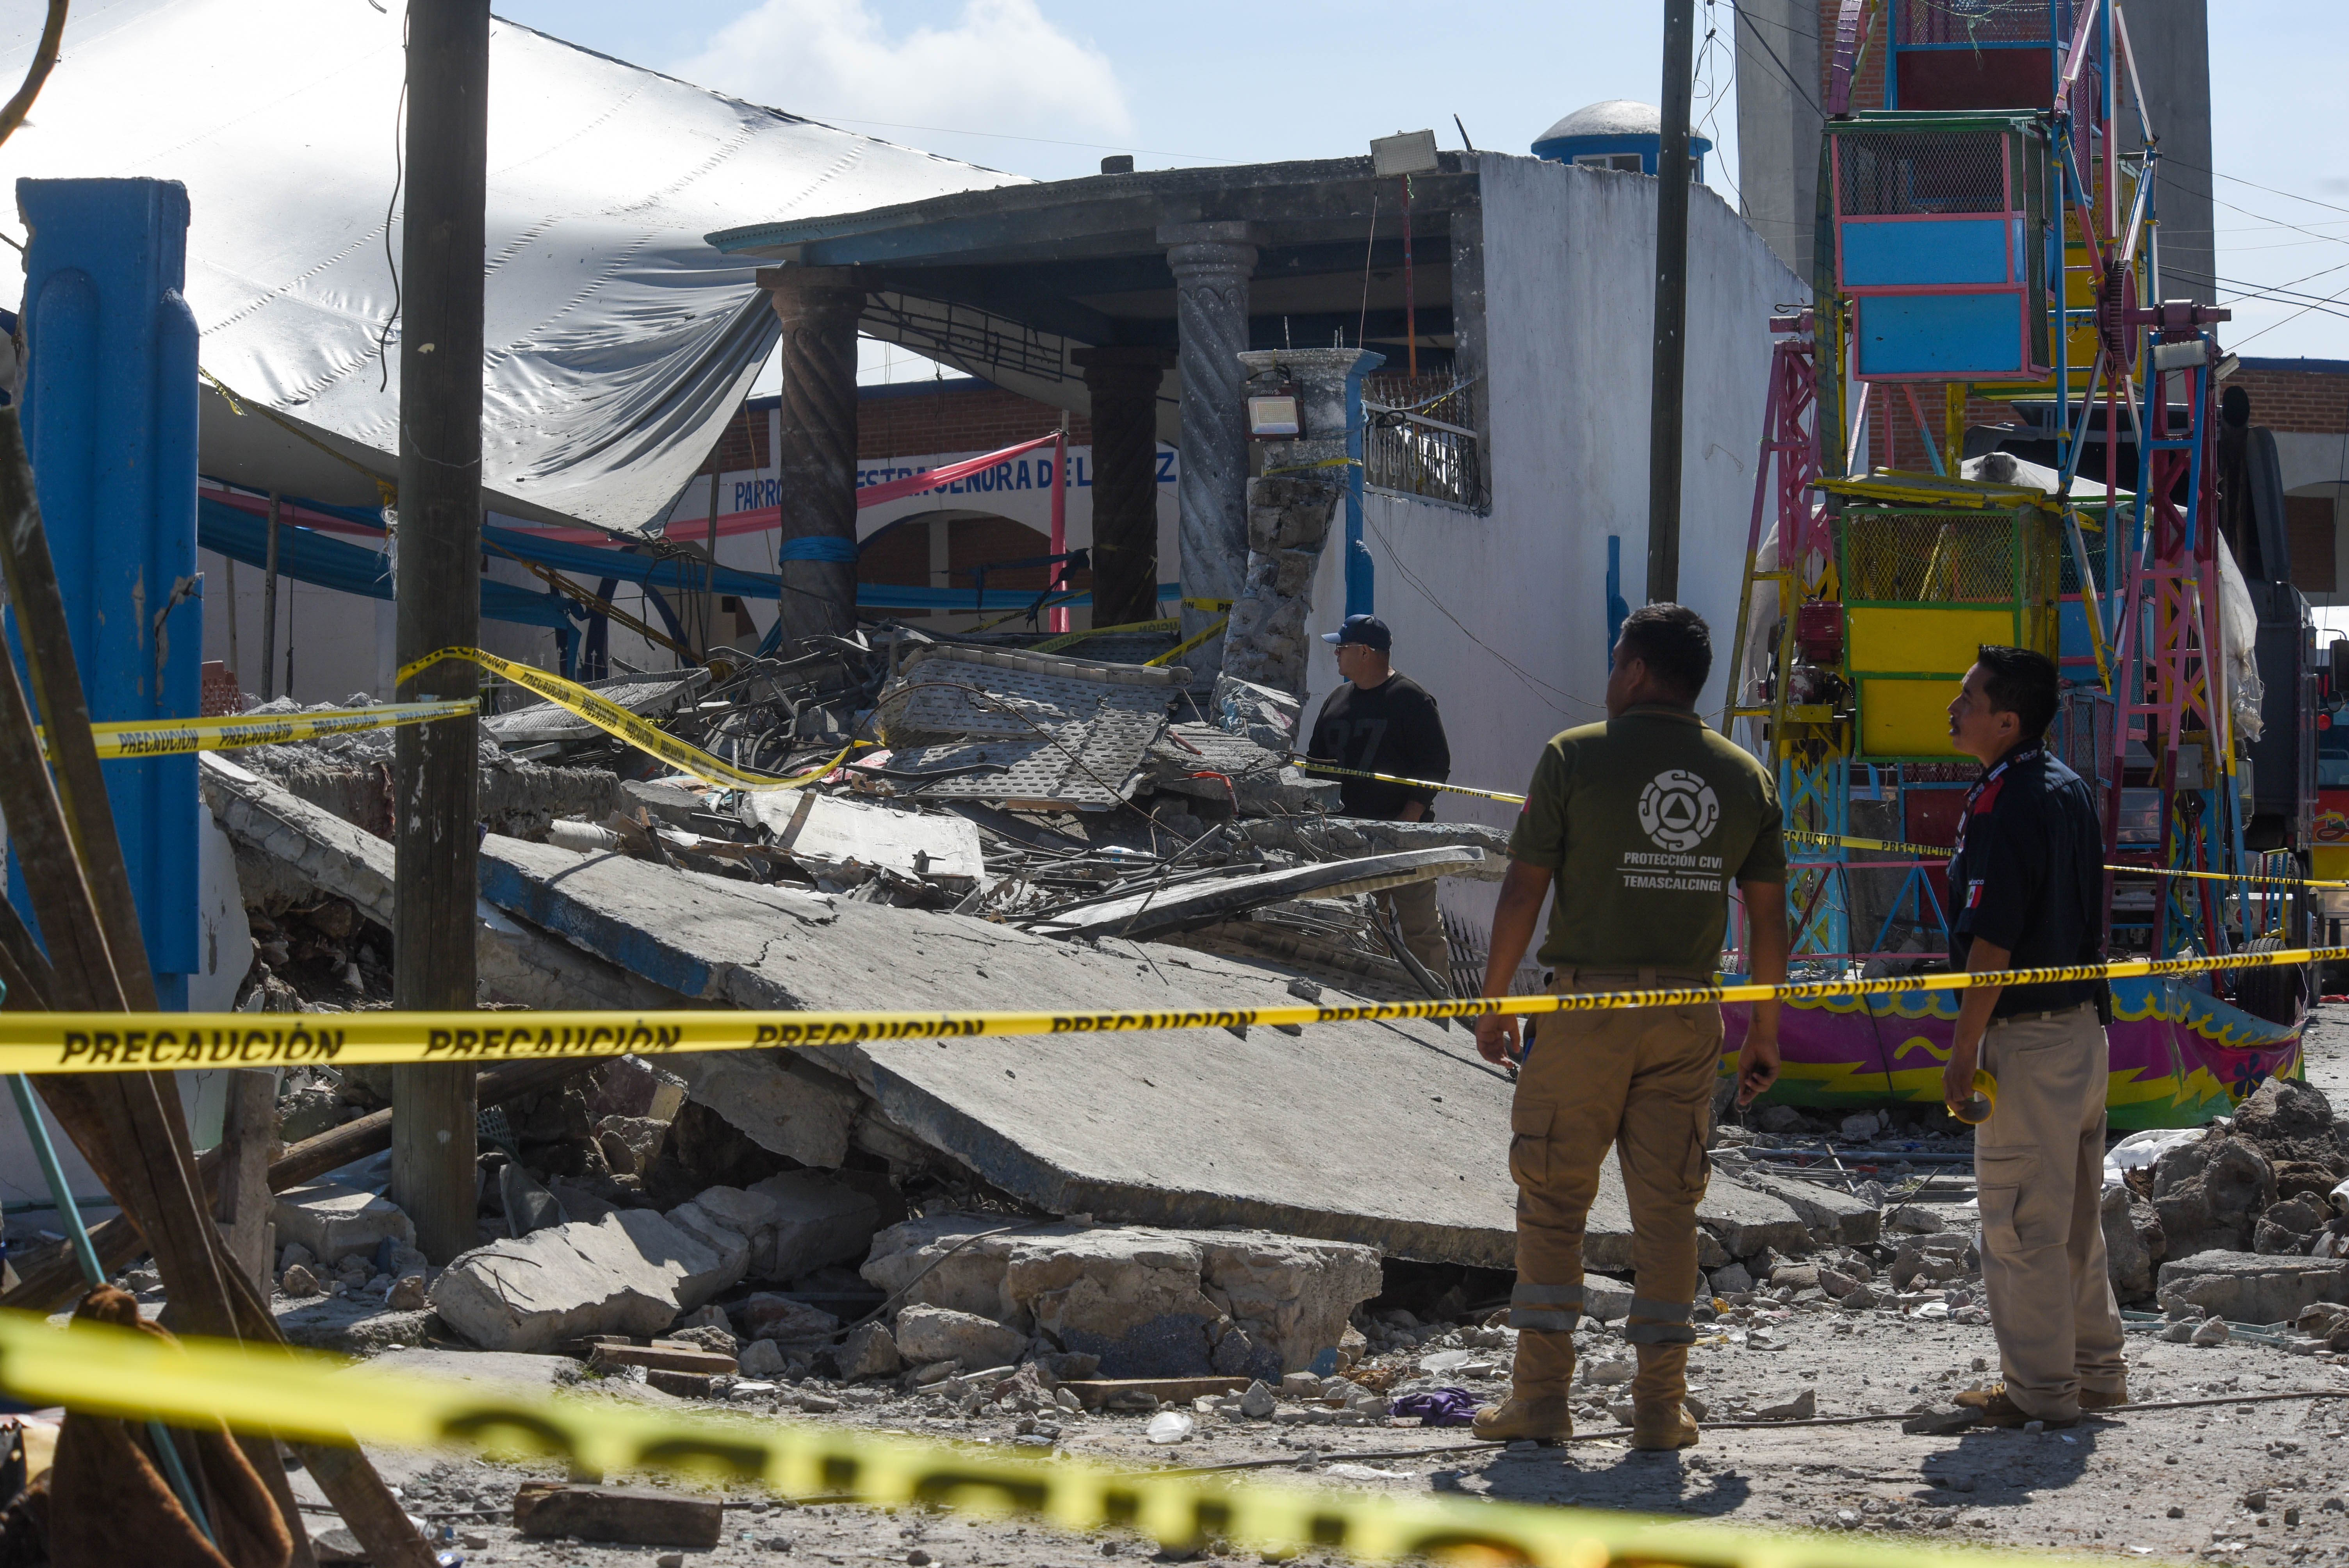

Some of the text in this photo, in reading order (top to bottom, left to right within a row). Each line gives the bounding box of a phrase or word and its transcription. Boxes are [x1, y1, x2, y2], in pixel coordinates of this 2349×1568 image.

[118, 724, 199, 754] PRECAUCIÓN
[219, 718, 293, 747] PRECAUCIÓN
[1624, 852, 1696, 867] PROTECCIÓN
[59, 1021, 345, 1064] PRECAUCIÓN
